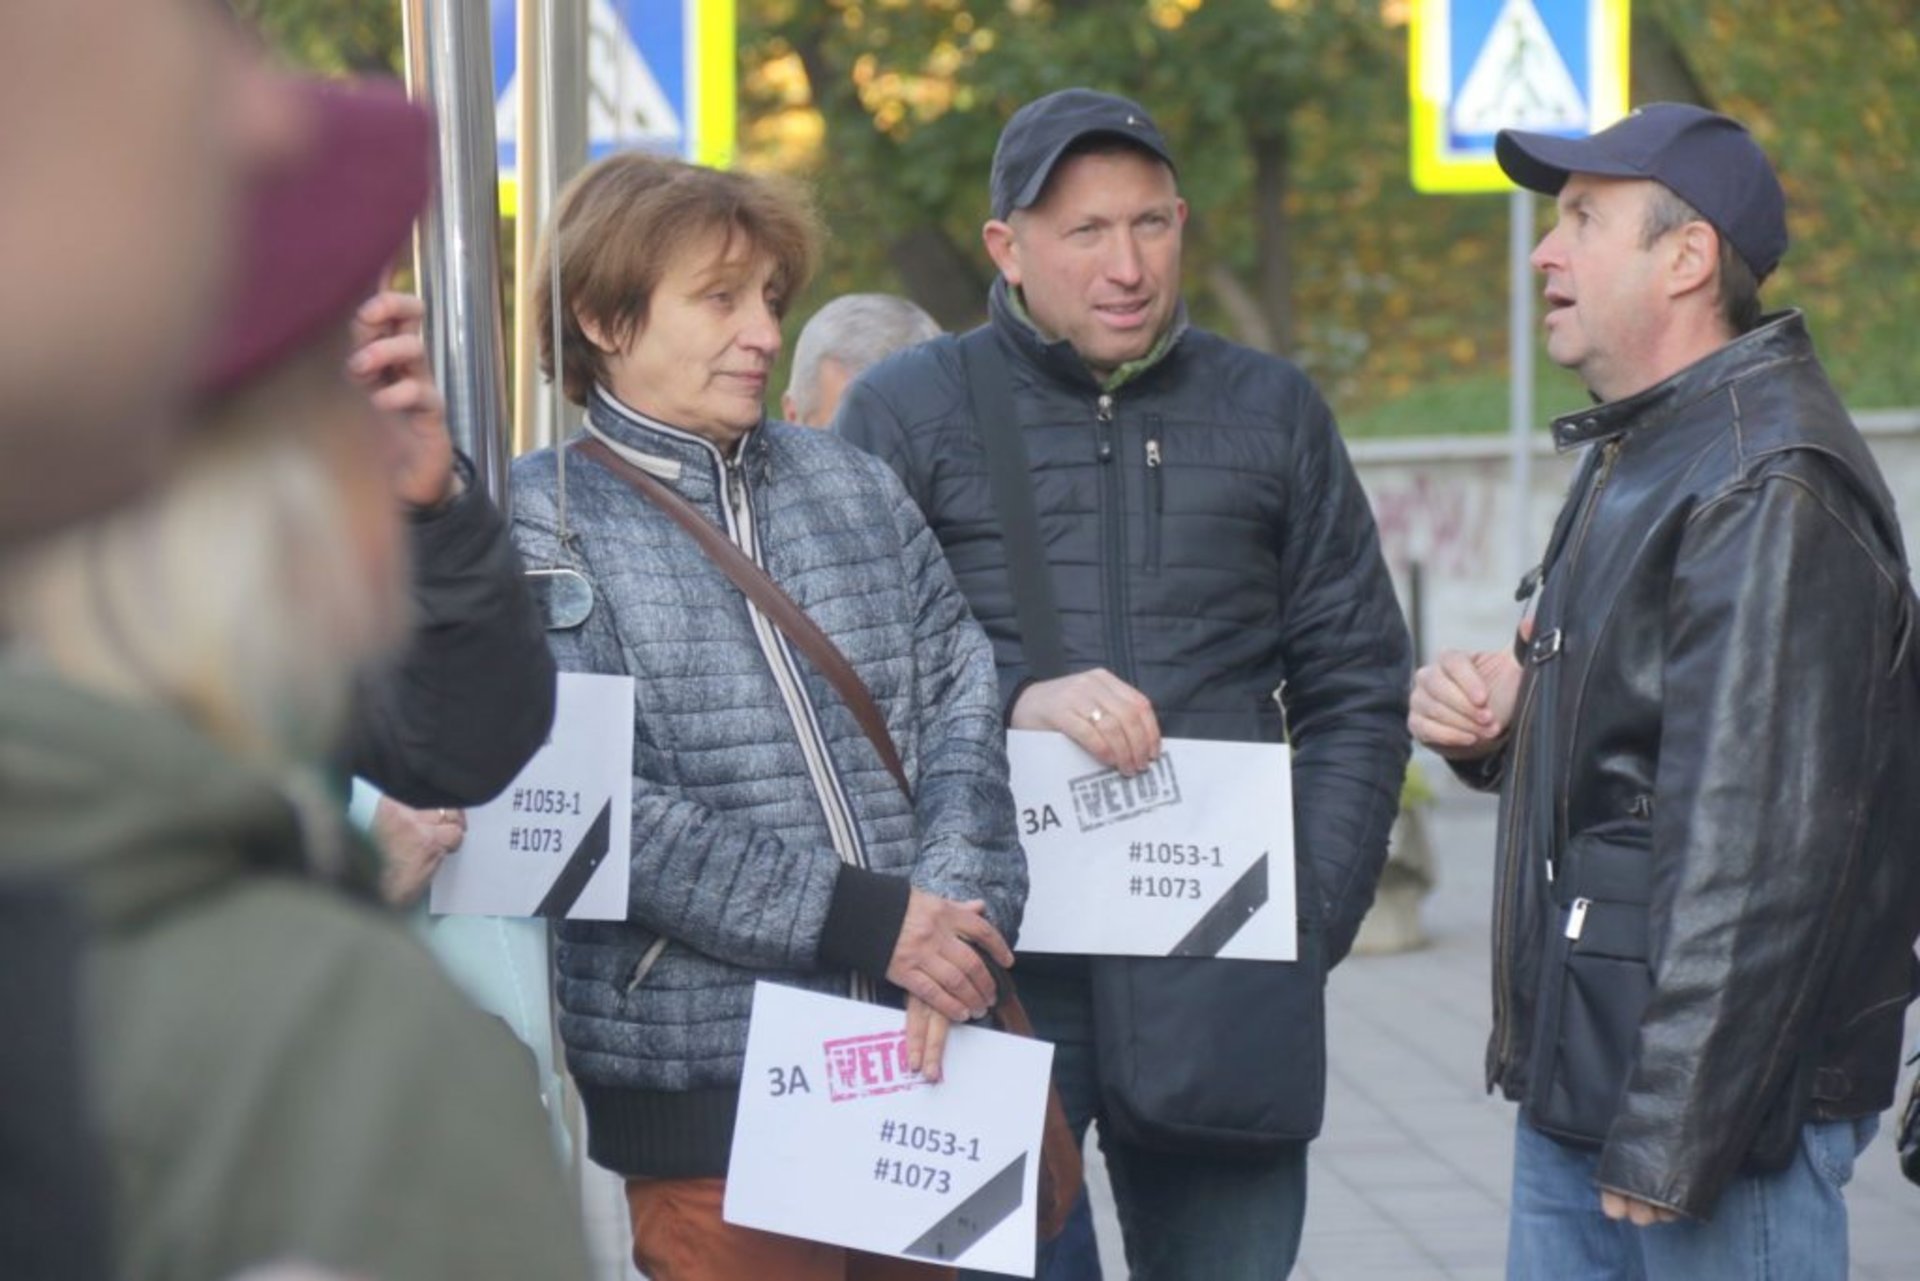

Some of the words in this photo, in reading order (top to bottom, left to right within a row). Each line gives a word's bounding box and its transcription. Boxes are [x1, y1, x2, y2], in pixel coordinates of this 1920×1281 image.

[512, 787, 581, 815] #1053-1
[509, 826, 563, 853] #1073
[1128, 841, 1224, 867] #1053-1
[1129, 876, 1202, 900] #1073
[879, 1118, 981, 1162] #1053-1
[873, 1157, 952, 1195] #1073
